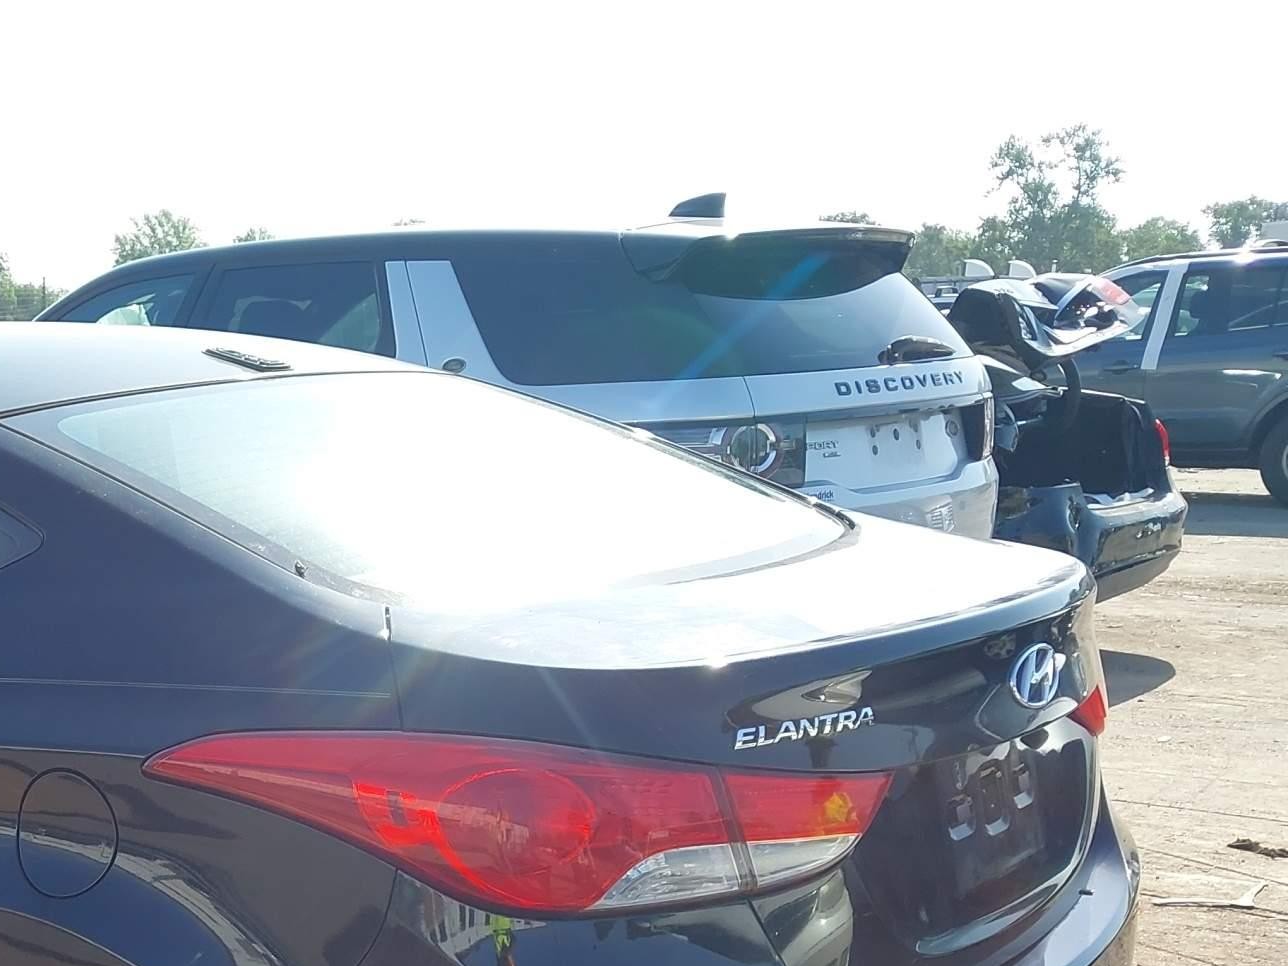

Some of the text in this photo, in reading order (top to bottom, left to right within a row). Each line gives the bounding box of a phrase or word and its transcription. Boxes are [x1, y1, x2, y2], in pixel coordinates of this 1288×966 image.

[834, 371, 964, 396] DISCOVERY
[806, 440, 839, 450] PORT
[734, 706, 875, 750] ELANTRA
